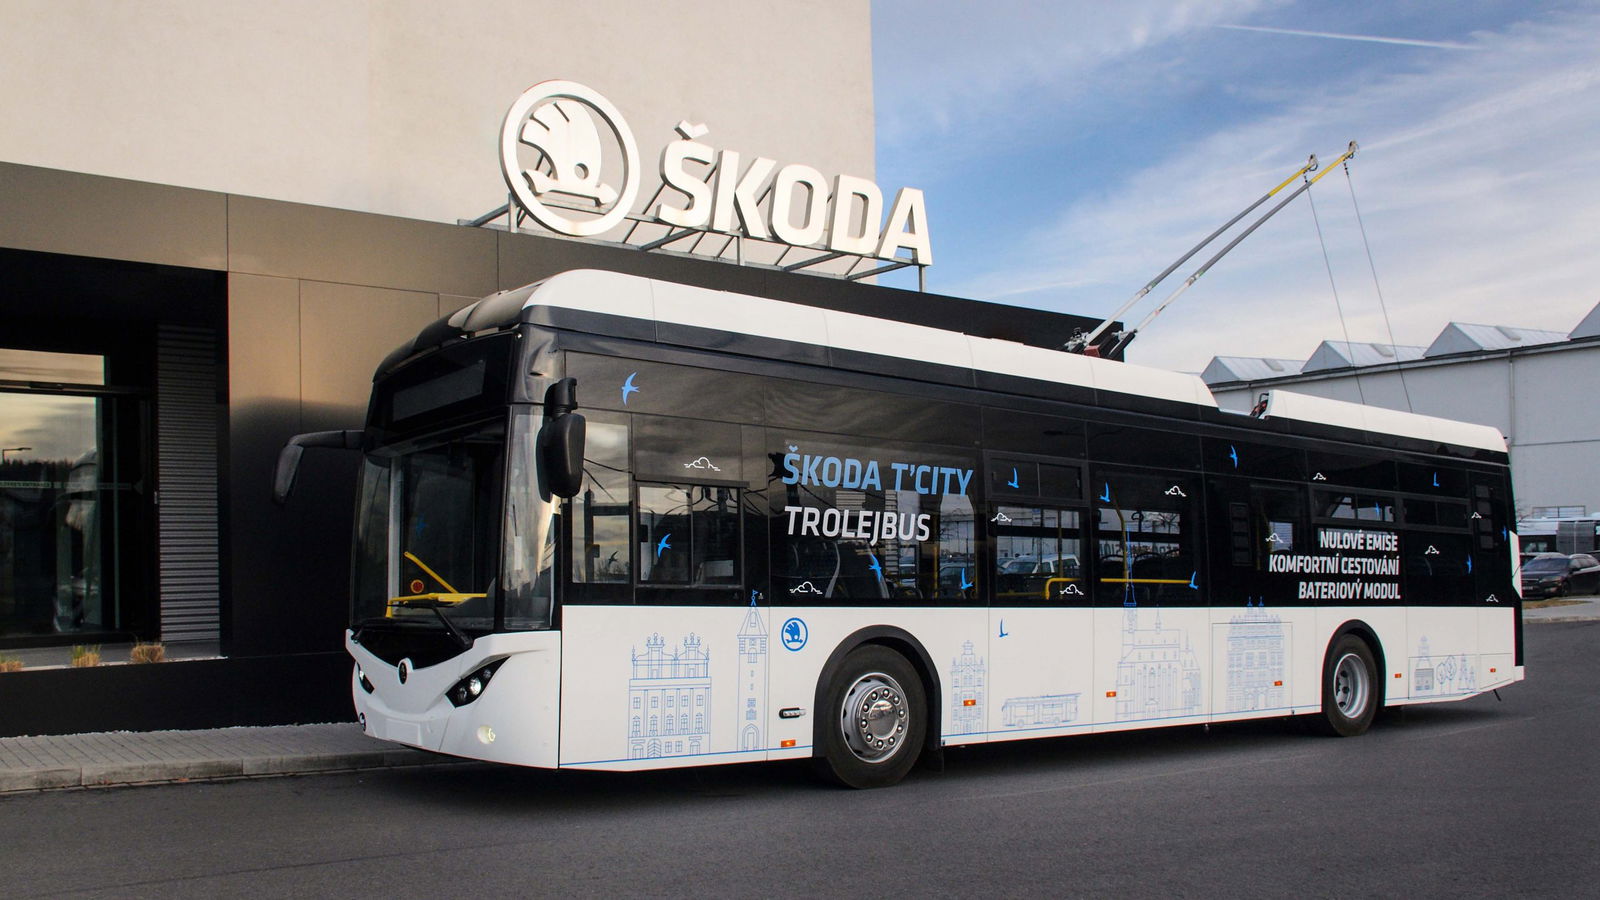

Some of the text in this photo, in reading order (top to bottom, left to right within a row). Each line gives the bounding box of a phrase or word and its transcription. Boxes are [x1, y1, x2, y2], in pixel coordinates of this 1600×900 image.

[655, 119, 933, 266] ŠKODA
[782, 444, 882, 491] ŠKODA
[784, 505, 931, 546] TROLEJBUS
[1320, 529, 1398, 551] NULOVÉ EMISE
[1269, 552, 1400, 576] KOMFORTNÍ CESTOVÁNÍ
[1298, 578, 1401, 599] BATERIOVÝ MODUL
